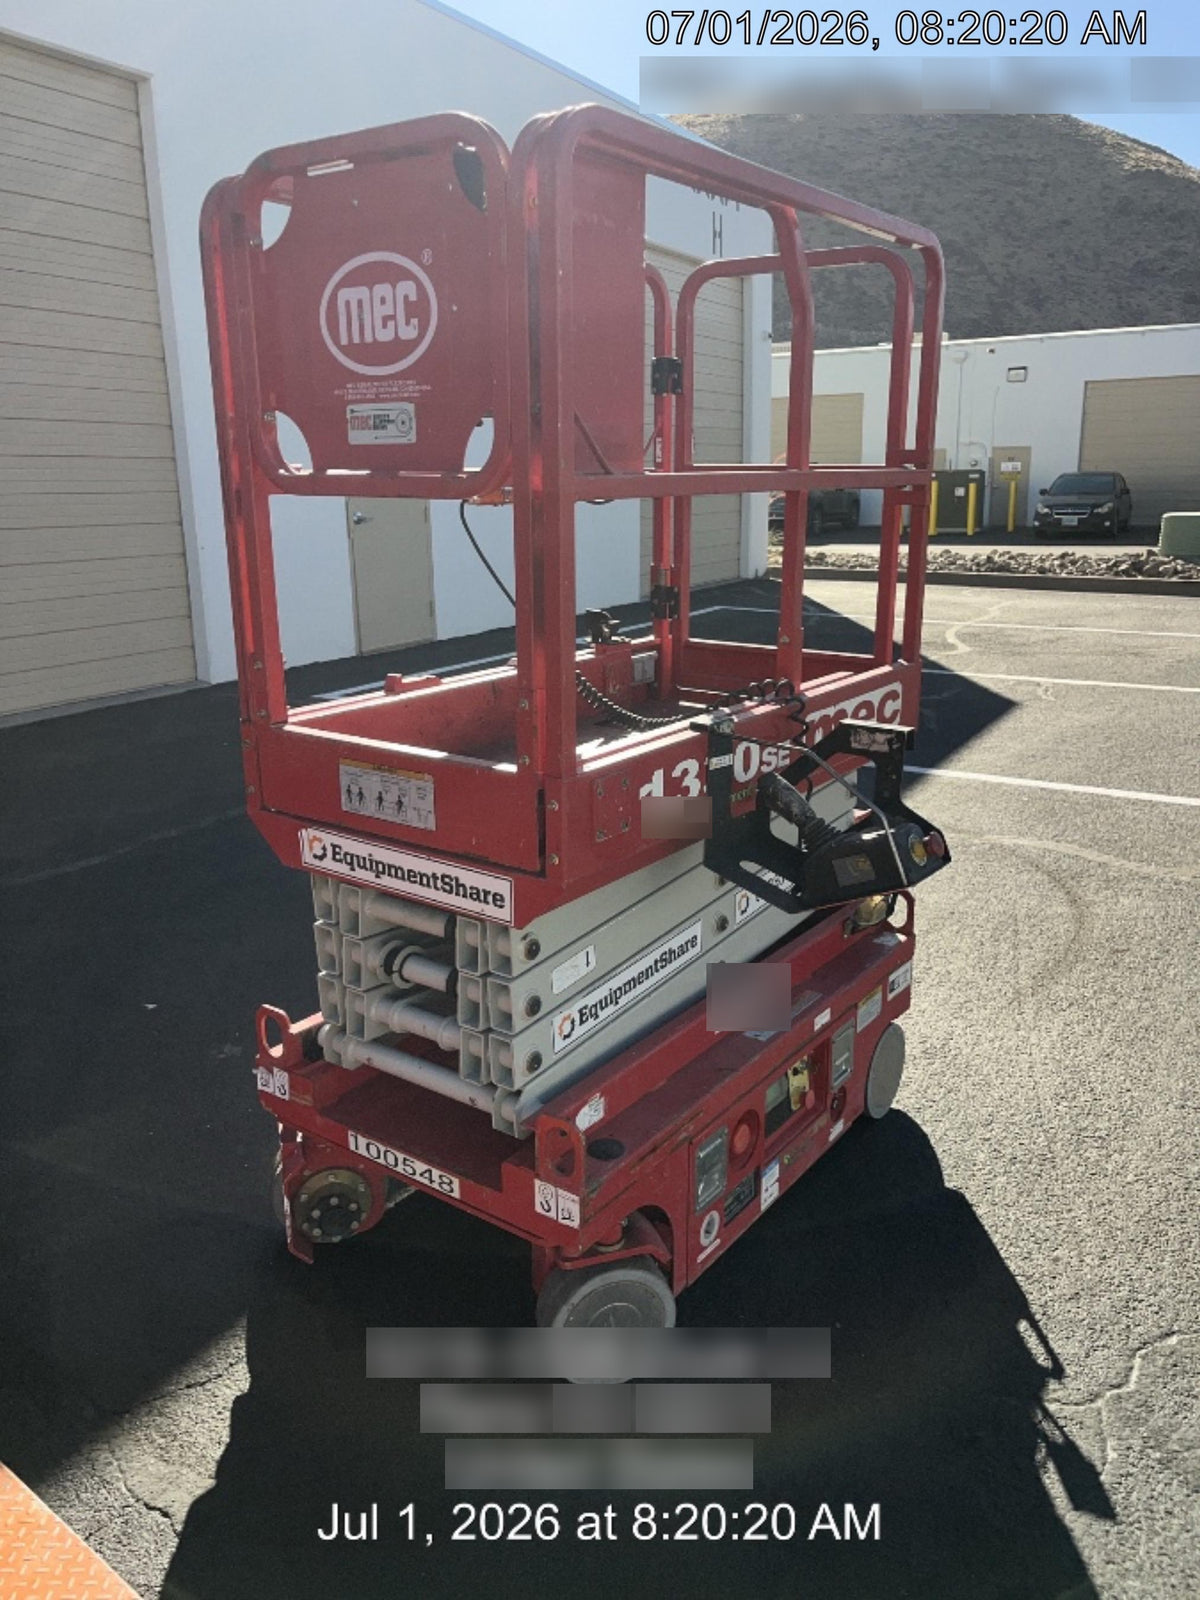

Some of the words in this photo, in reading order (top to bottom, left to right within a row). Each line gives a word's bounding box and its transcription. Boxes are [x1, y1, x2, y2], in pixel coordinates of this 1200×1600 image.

[337, 280, 418, 346] mec
[330, 843, 506, 909] EquipmentShare
[577, 934, 698, 1027] EquipmentShare
[350, 1133, 454, 1194] 100548
